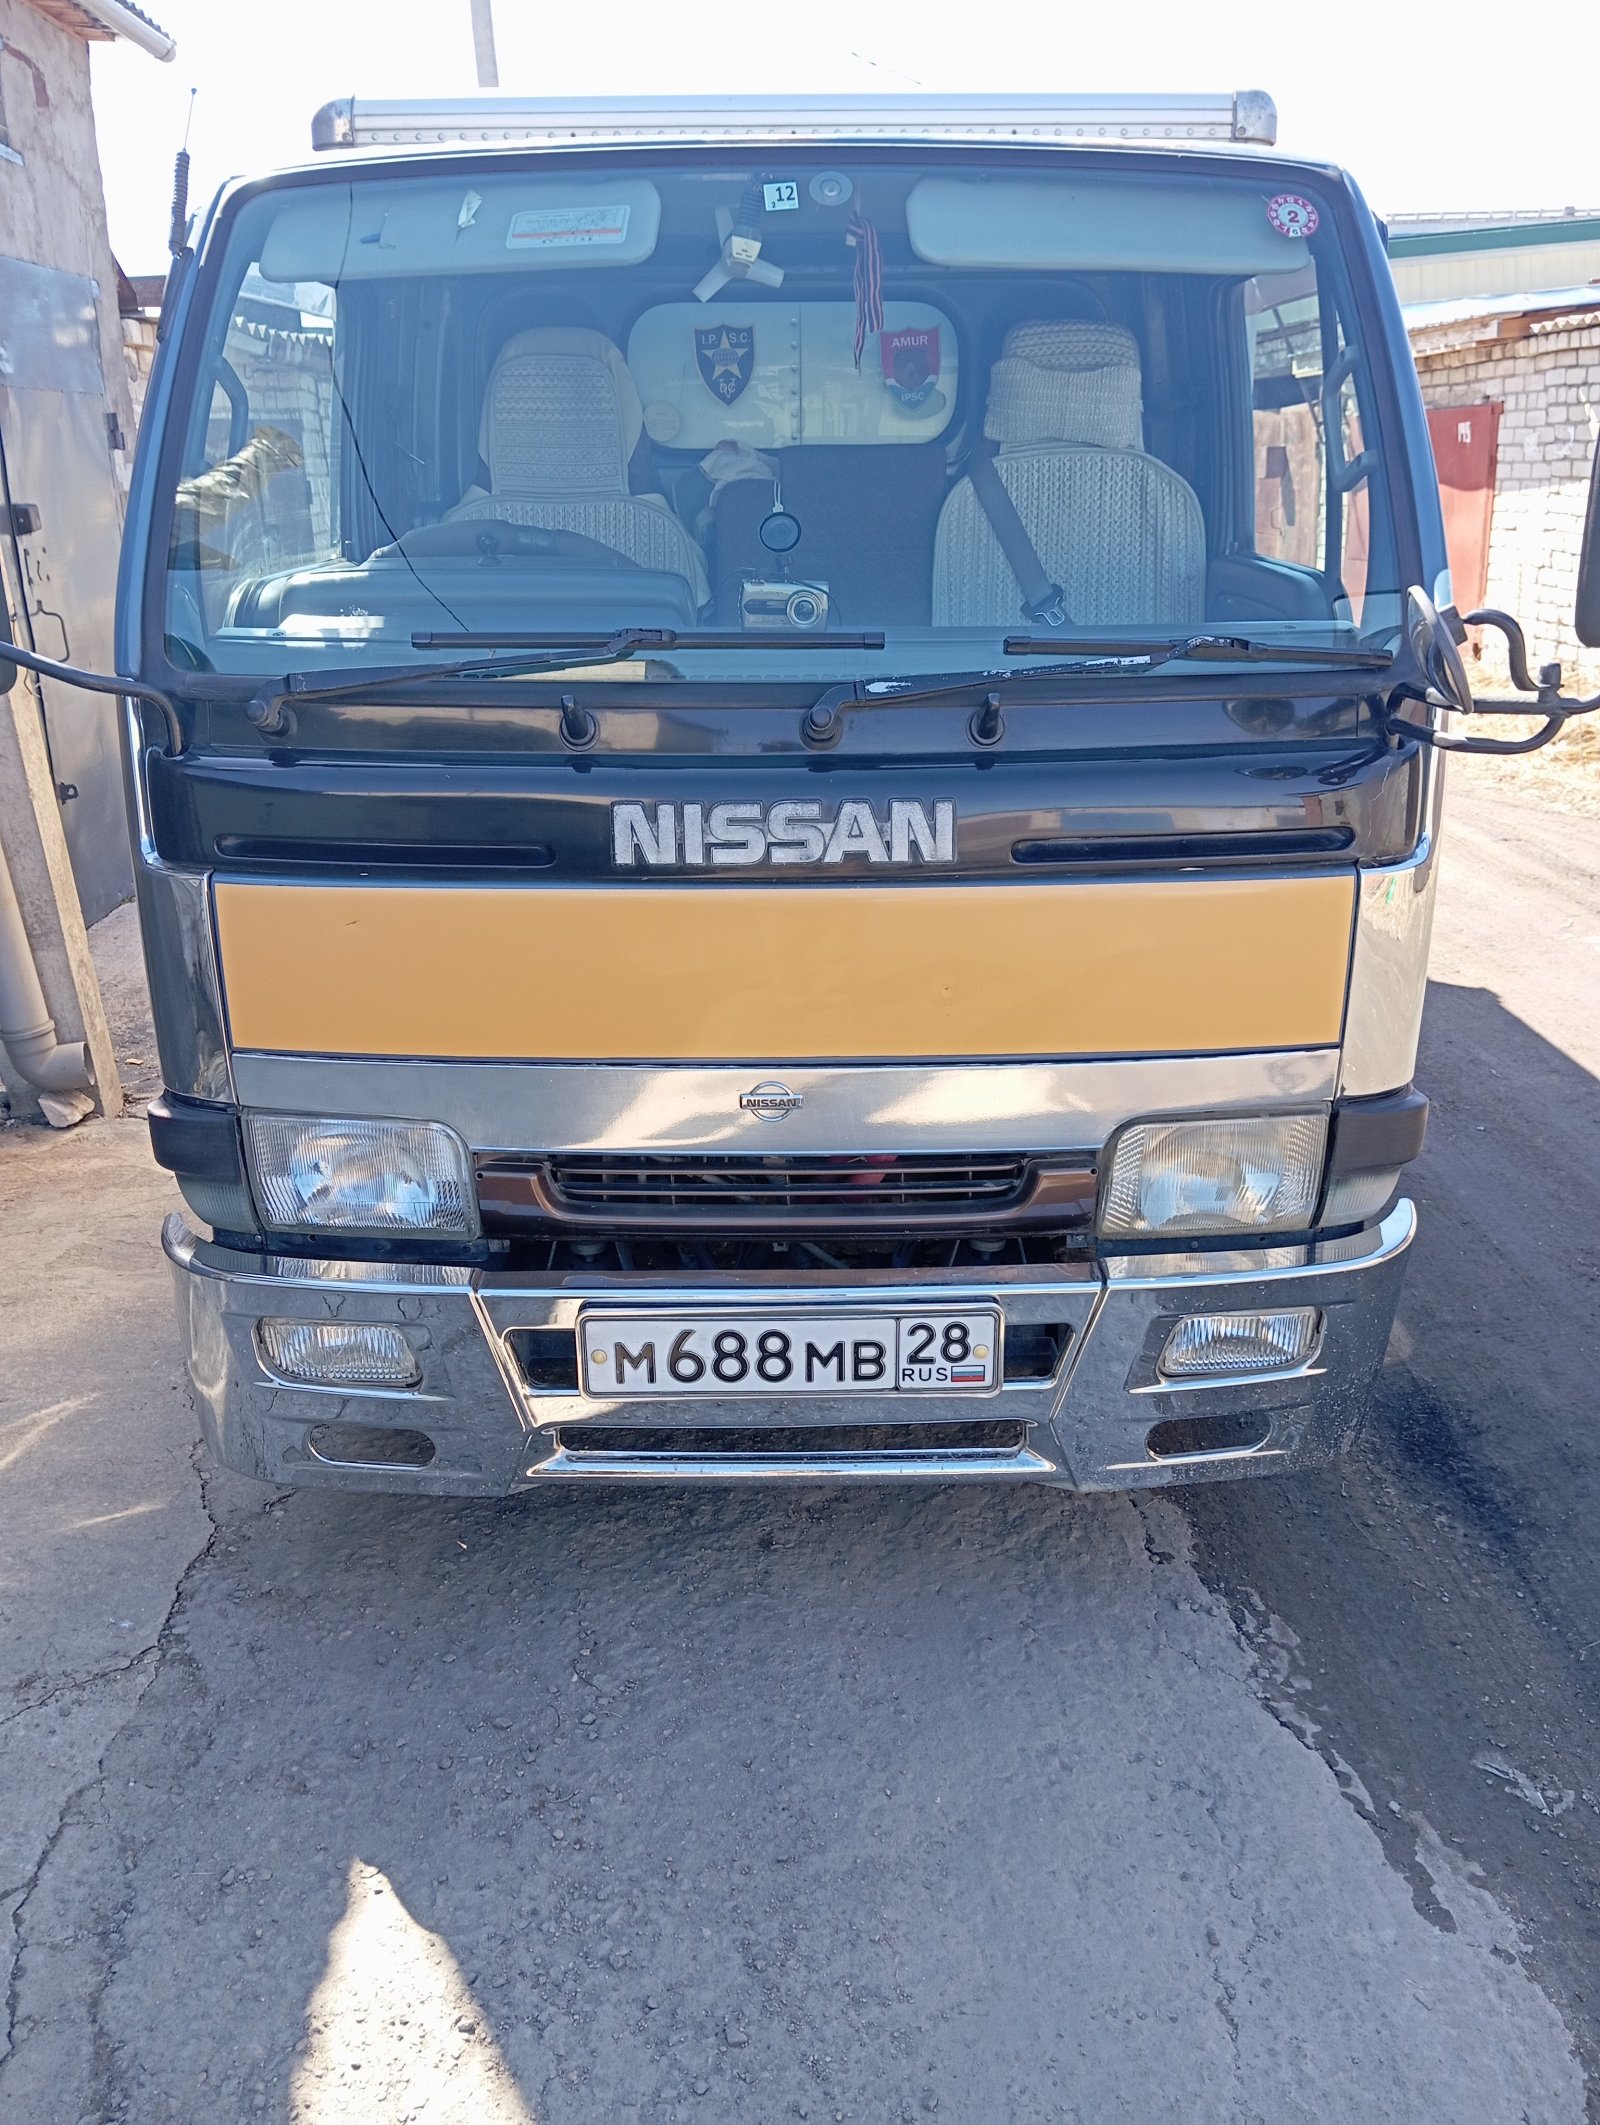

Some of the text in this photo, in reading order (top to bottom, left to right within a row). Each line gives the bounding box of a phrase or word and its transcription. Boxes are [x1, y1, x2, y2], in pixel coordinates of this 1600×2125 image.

[776, 185, 796, 201] 12
[1287, 210, 1300, 223] 2
[892, 335, 928, 348] AMUR
[901, 391, 926, 402] IPSC
[612, 800, 955, 865] NISSAN
[746, 1098, 797, 1108] NISSAN
[906, 1322, 972, 1364] 28
[901, 1367, 949, 1383] RUS
